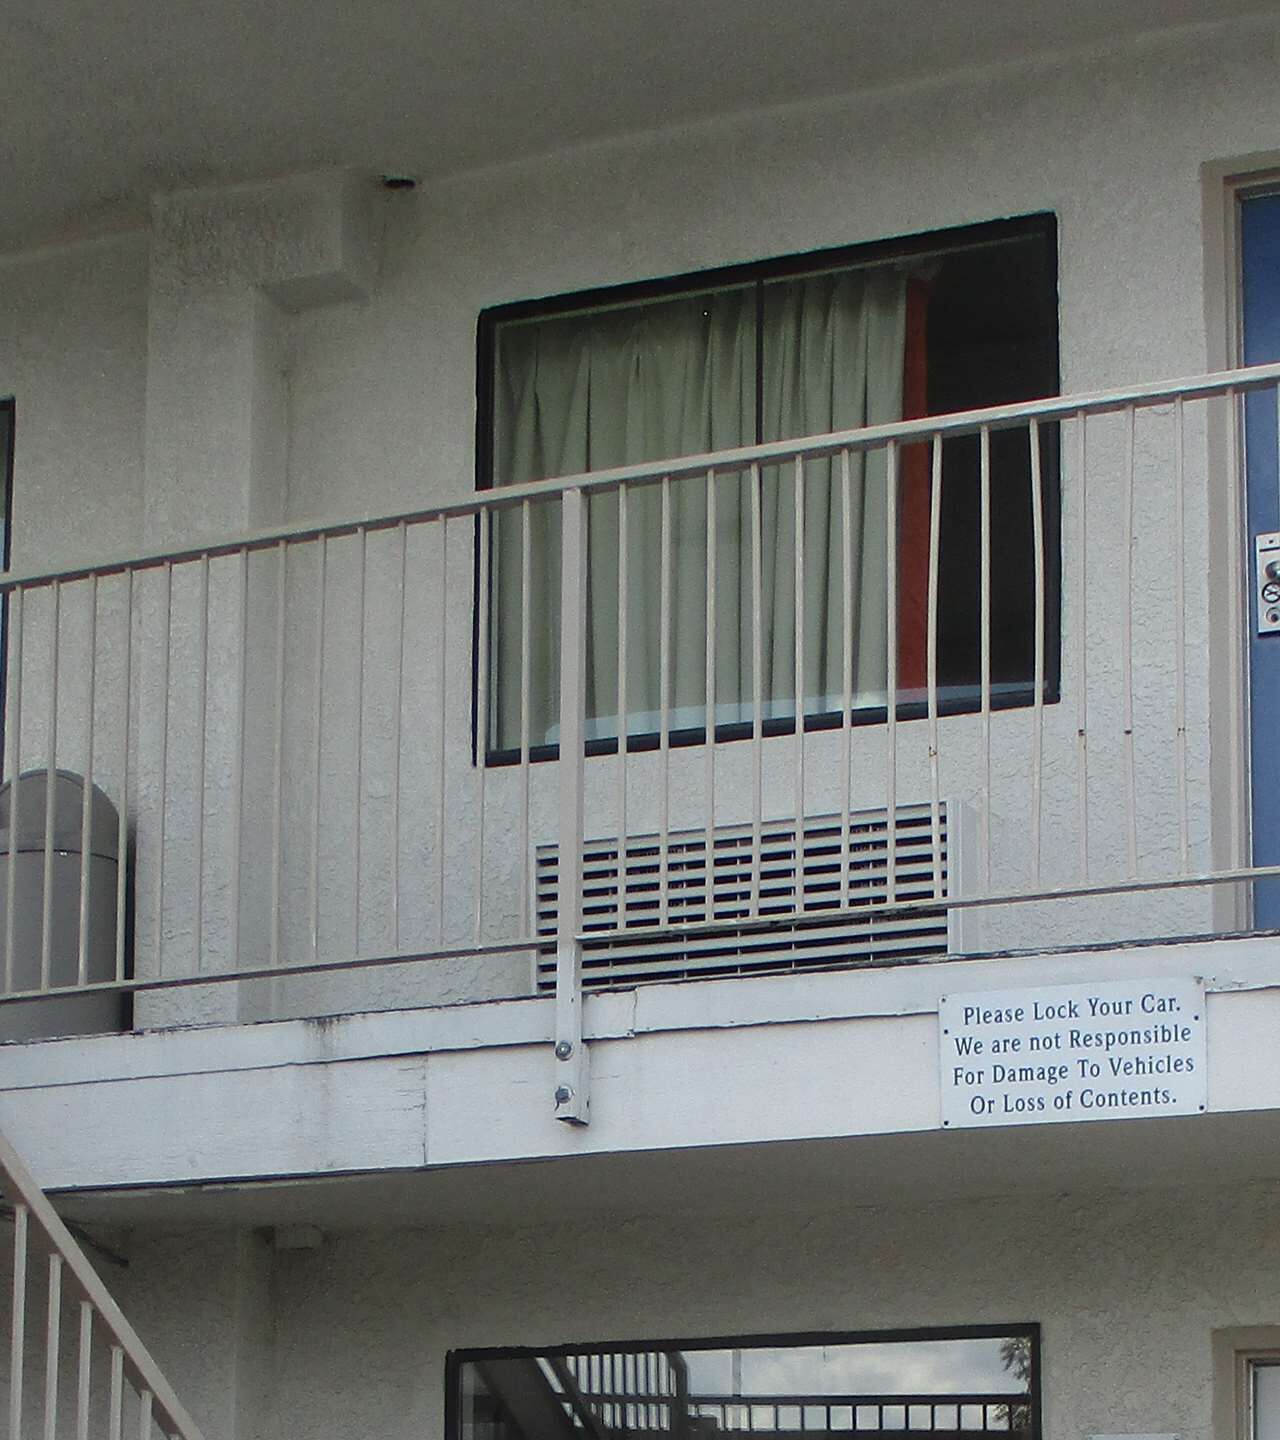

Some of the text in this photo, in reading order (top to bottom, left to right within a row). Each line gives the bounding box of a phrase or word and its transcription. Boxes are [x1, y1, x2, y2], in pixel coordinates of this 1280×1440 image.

[963, 993, 1181, 1026] Please Lock Your Car.
[954, 1024, 1192, 1057] We are not Responsible
[952, 1054, 1195, 1086] For Damage To Vehicles
[969, 1086, 1177, 1115] Or Loss of Contents.
